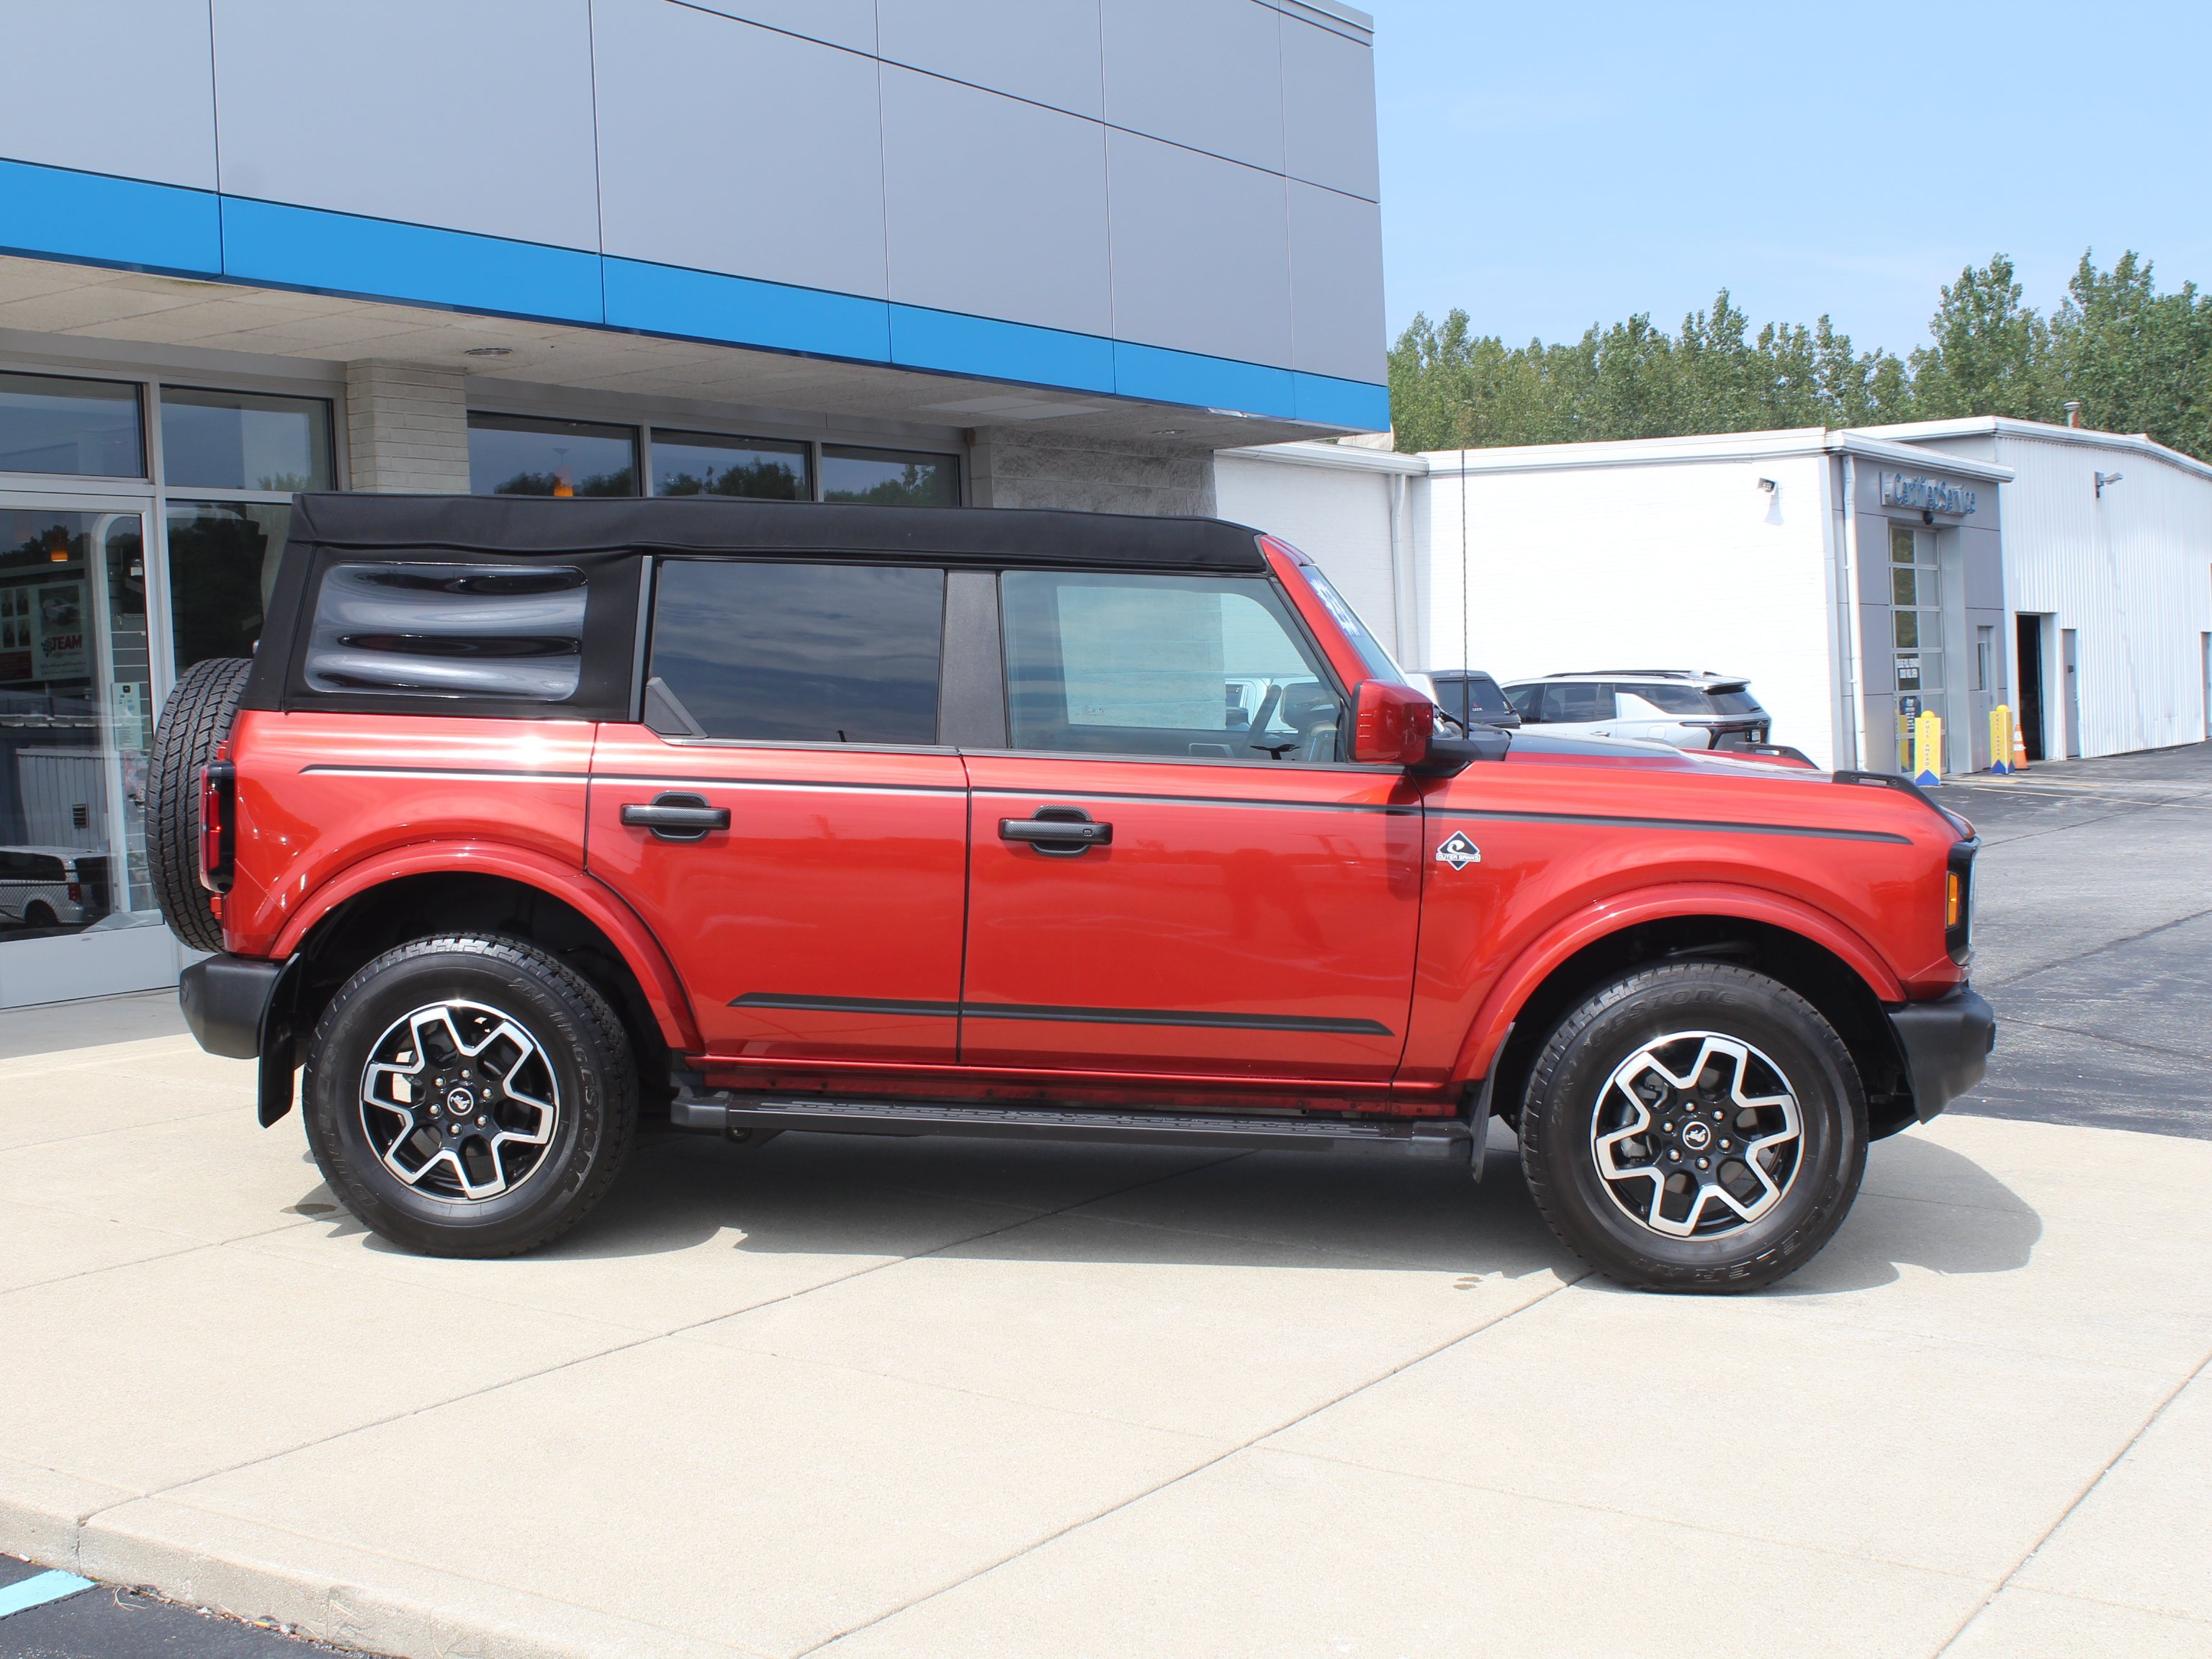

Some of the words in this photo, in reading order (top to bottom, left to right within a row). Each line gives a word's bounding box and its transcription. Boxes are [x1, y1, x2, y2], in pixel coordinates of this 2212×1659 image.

[1894, 473, 1938, 508] Certified
[1938, 481, 1975, 513] Service
[51, 634, 82, 650] TEAM
